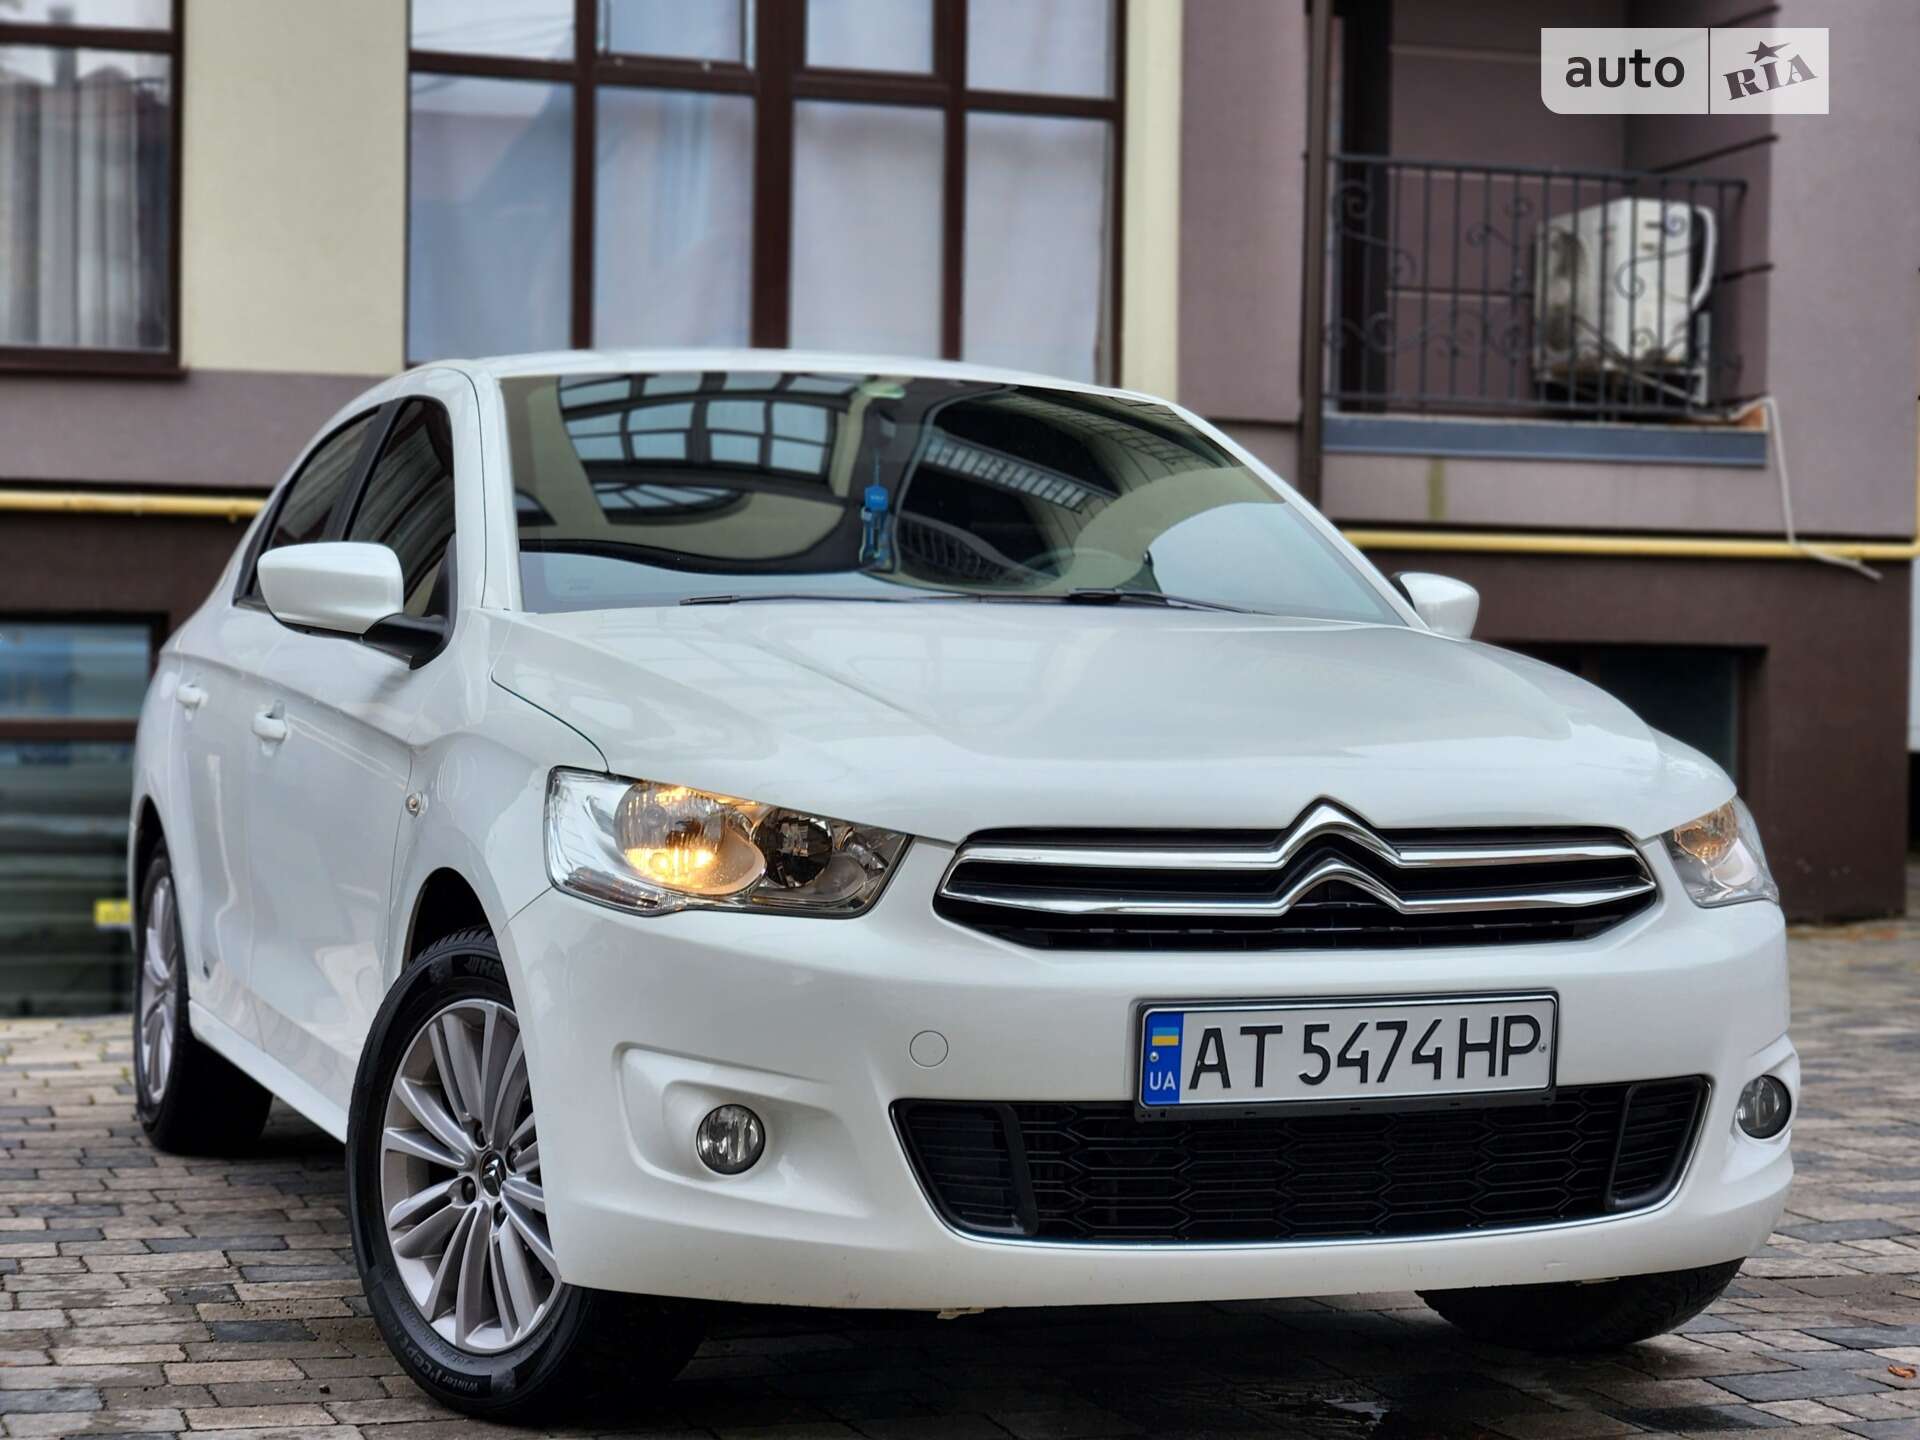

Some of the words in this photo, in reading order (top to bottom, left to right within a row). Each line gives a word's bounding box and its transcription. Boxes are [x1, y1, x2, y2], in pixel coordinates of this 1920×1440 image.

[1188, 1025, 1284, 1090] AT
[1298, 1018, 1442, 1086] 5474
[1456, 1014, 1541, 1079] HP
[1149, 1071, 1177, 1091] UA
